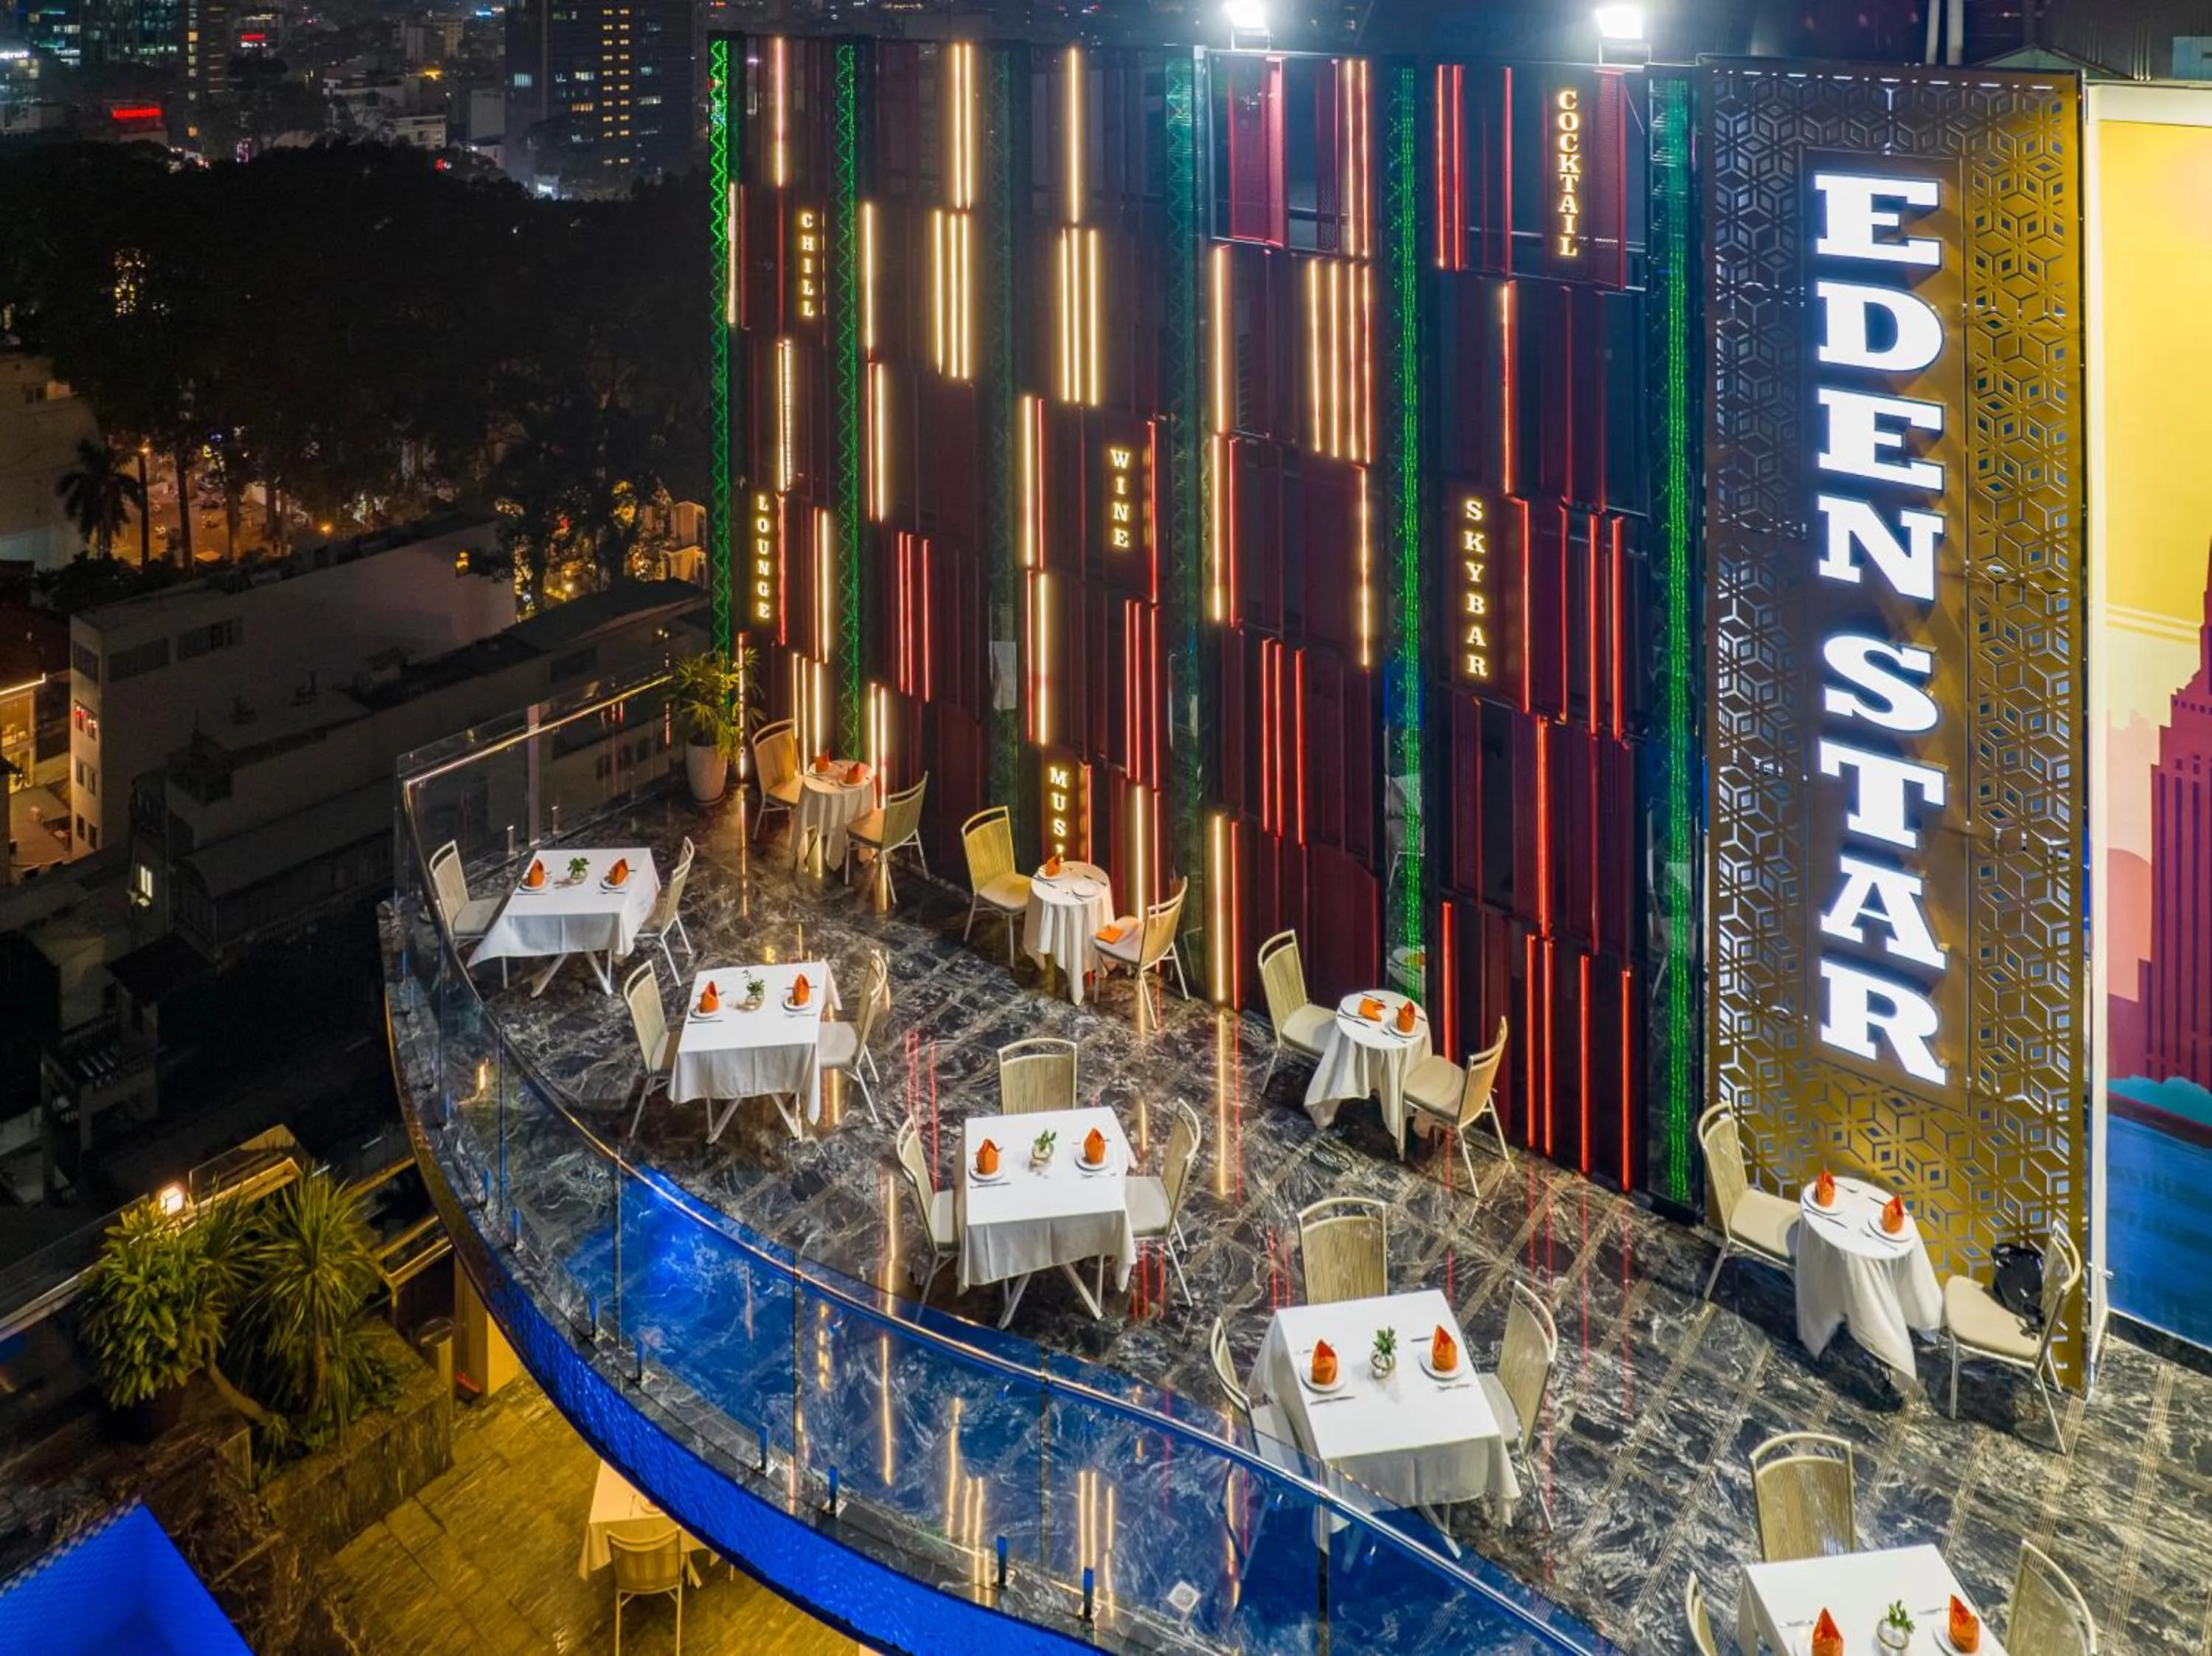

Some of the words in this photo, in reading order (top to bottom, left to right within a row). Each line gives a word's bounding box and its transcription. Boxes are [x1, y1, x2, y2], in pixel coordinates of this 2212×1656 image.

[1558, 90, 1581, 257] COCKTAIL
[801, 212, 815, 316] CHILL
[1110, 448, 1130, 548] WINE
[757, 495, 770, 619] LOUNGE
[1464, 500, 1487, 677] SKYBAR
[1049, 766, 1068, 862] MUSI
